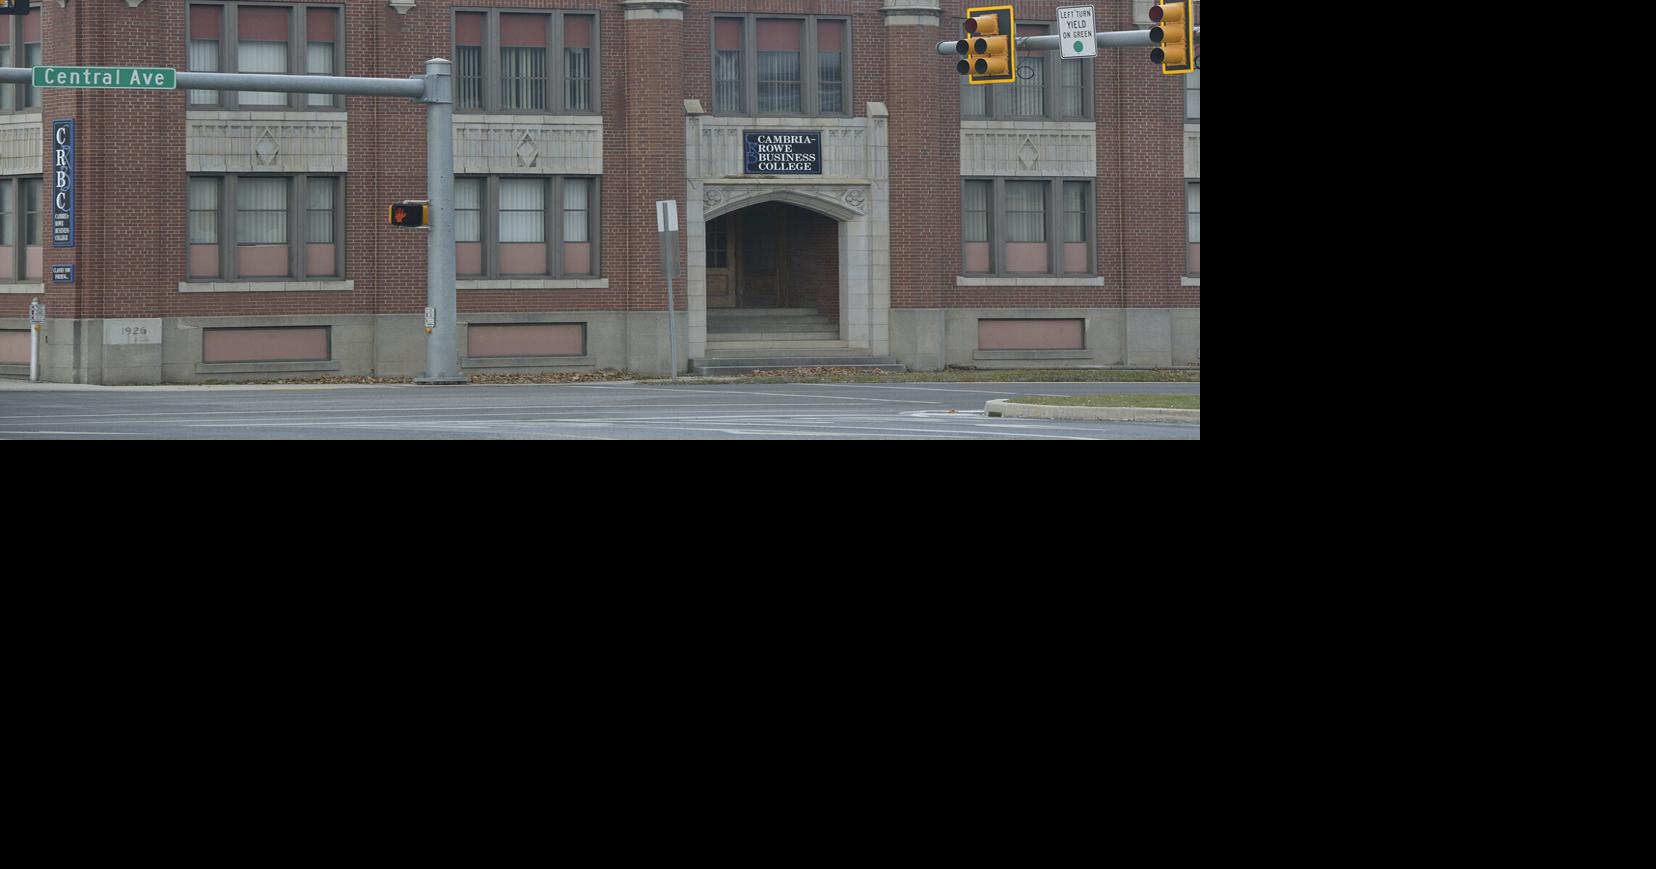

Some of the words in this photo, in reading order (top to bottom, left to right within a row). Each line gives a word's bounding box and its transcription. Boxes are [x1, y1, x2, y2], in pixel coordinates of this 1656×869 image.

[1060, 10, 1074, 18] LEFT
[1066, 20, 1086, 29] YIELD
[44, 68, 120, 85] Central
[130, 69, 165, 85] Ave
[758, 136, 816, 144] CAMBRIA-
[758, 144, 792, 152] ROWE
[758, 154, 816, 162] BUSINESS
[758, 162, 812, 170] COLLEGE
[121, 326, 148, 336] 1926
